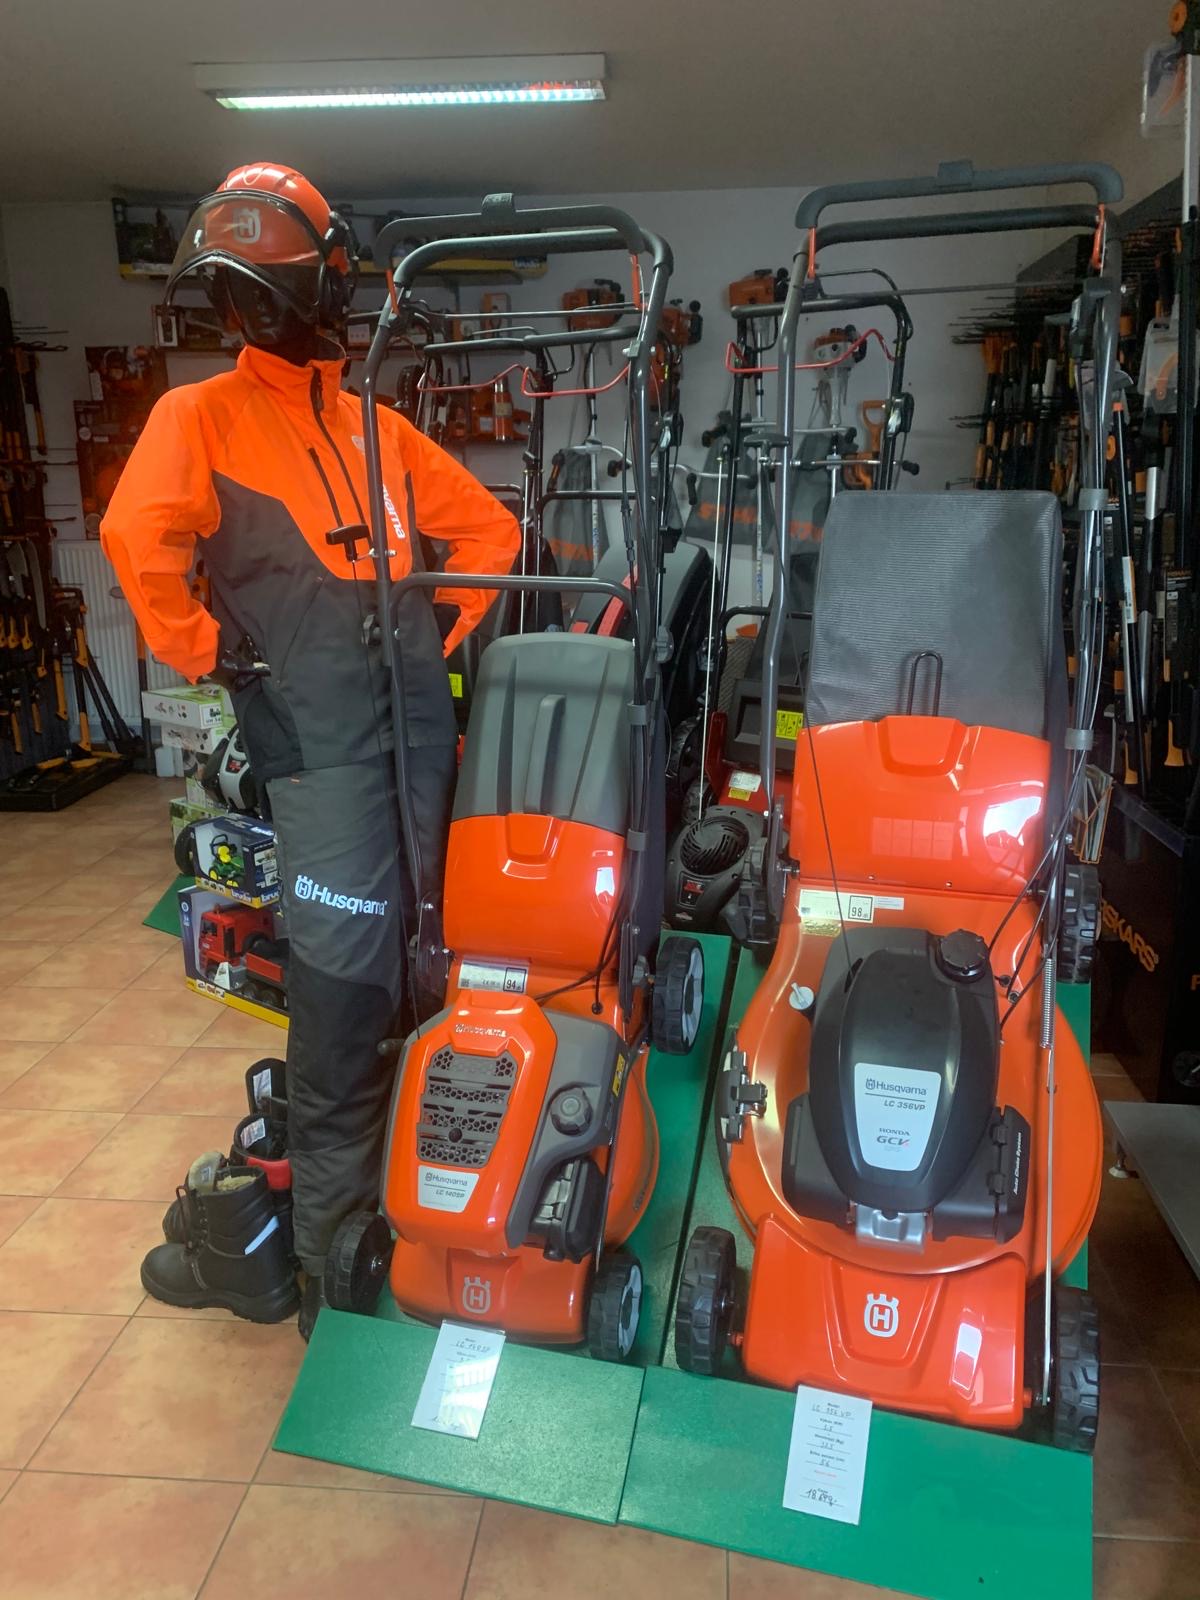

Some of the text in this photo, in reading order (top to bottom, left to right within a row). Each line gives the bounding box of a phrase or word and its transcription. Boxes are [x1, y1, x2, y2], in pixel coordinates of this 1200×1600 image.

[382, 484, 406, 539] varna
[311, 883, 385, 916] Husqvarna
[851, 906, 863, 918] 98
[506, 978, 517, 990] 94
[876, 1081, 927, 1096] Husqvarna
[897, 1102, 926, 1111] 356VP
[879, 1127, 911, 1136] HONDA
[432, 1174, 468, 1186] Husqvarna
